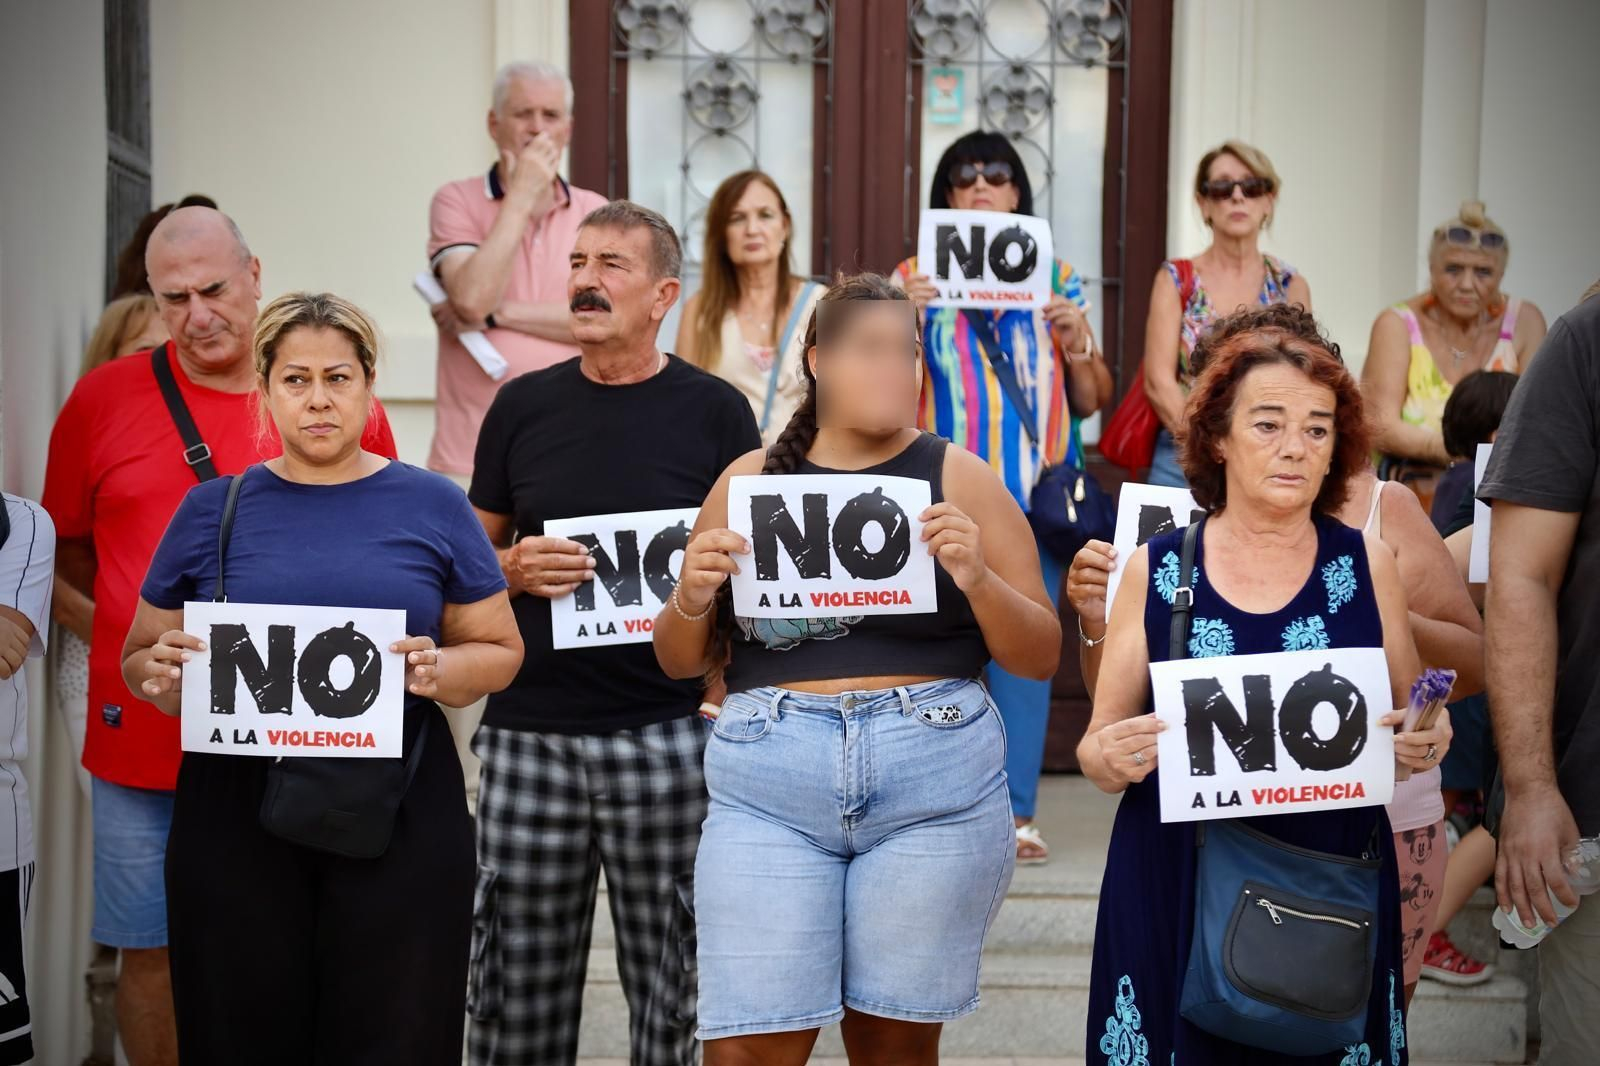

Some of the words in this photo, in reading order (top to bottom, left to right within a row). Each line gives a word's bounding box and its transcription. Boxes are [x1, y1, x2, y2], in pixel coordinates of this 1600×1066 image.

[948, 289, 963, 299] LA
[758, 592, 771, 608] A
[779, 592, 803, 608] LA
[809, 590, 912, 608] VIOLENCIA
[577, 624, 588, 637] A
[596, 621, 617, 636] LA
[209, 728, 224, 744] A
[233, 729, 258, 745] LA
[267, 729, 376, 748] VIOLENCIA
[1191, 791, 1206, 809] A
[1216, 790, 1242, 808] LA
[1252, 782, 1366, 805] VIOLENCIA
